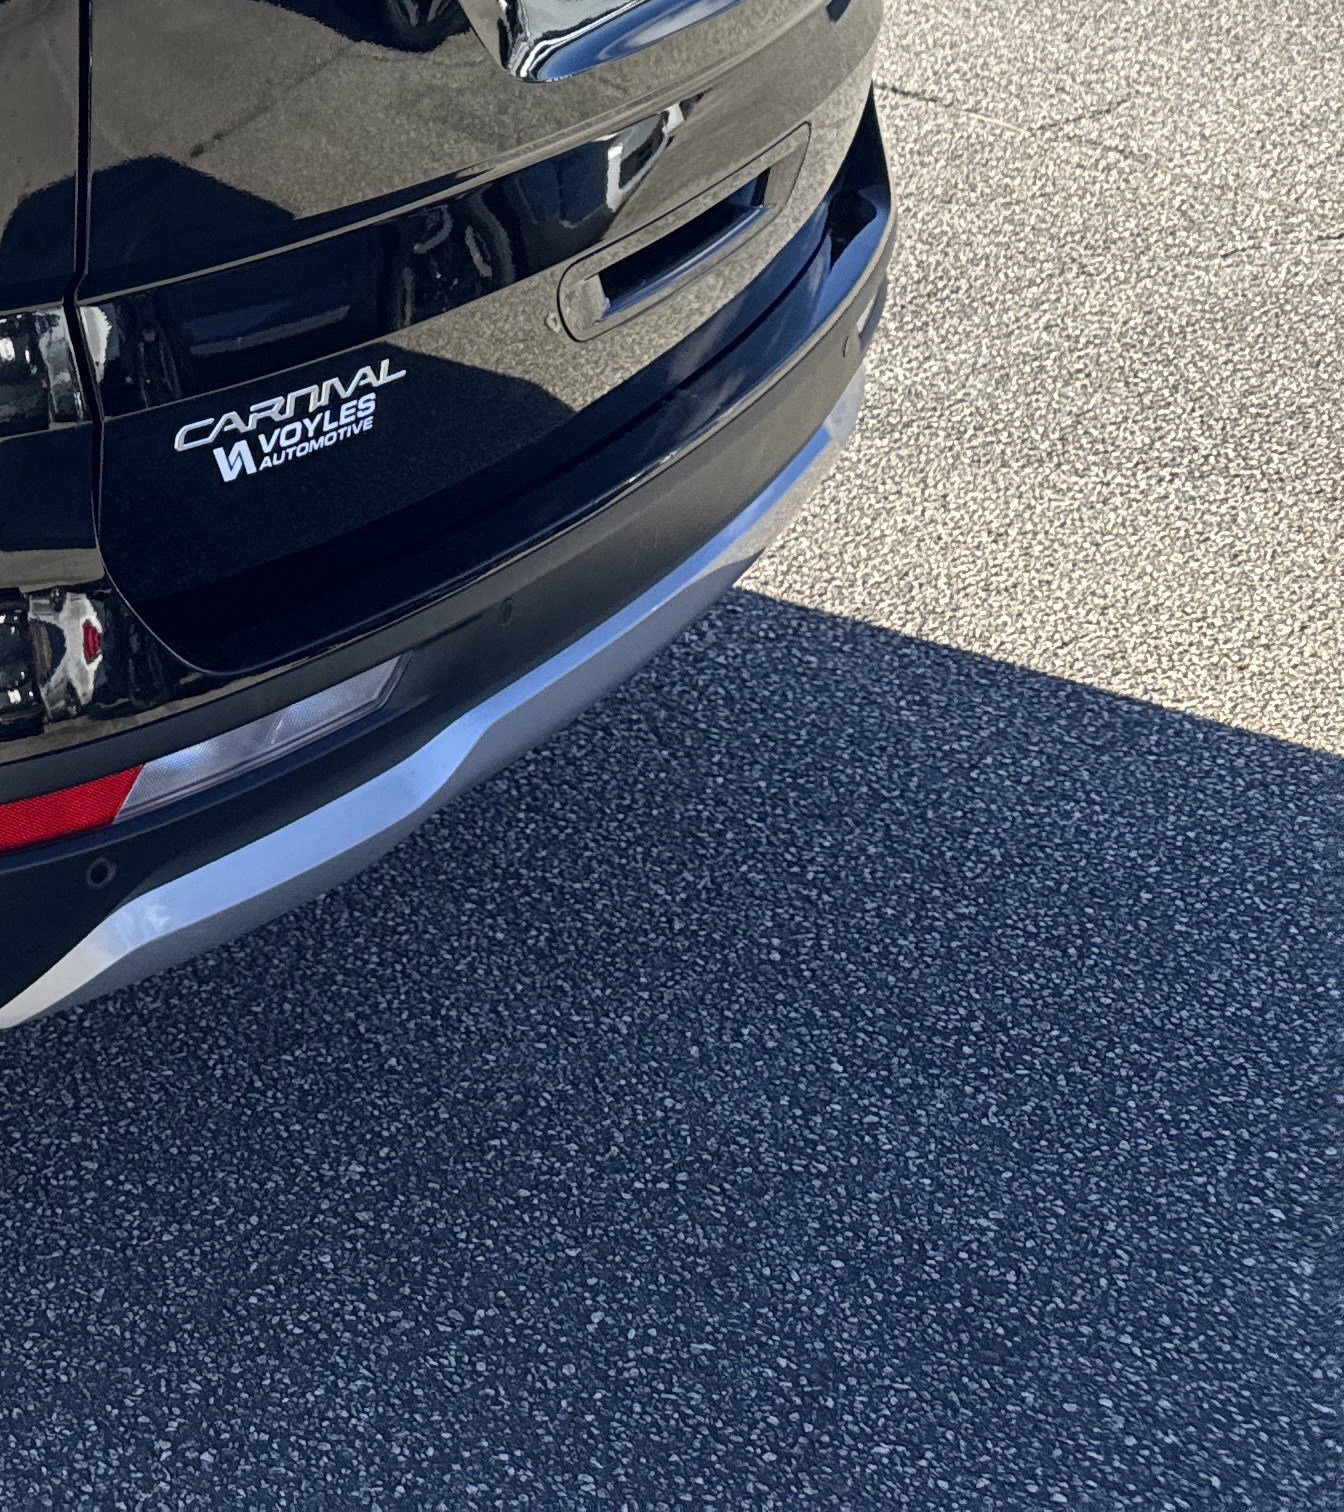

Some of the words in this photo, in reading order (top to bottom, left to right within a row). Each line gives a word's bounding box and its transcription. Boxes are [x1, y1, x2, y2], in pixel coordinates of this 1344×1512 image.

[174, 358, 407, 452] CARNIVAL
[258, 392, 377, 454] VOYLES
[259, 415, 374, 471] AUTOMOTIVE
